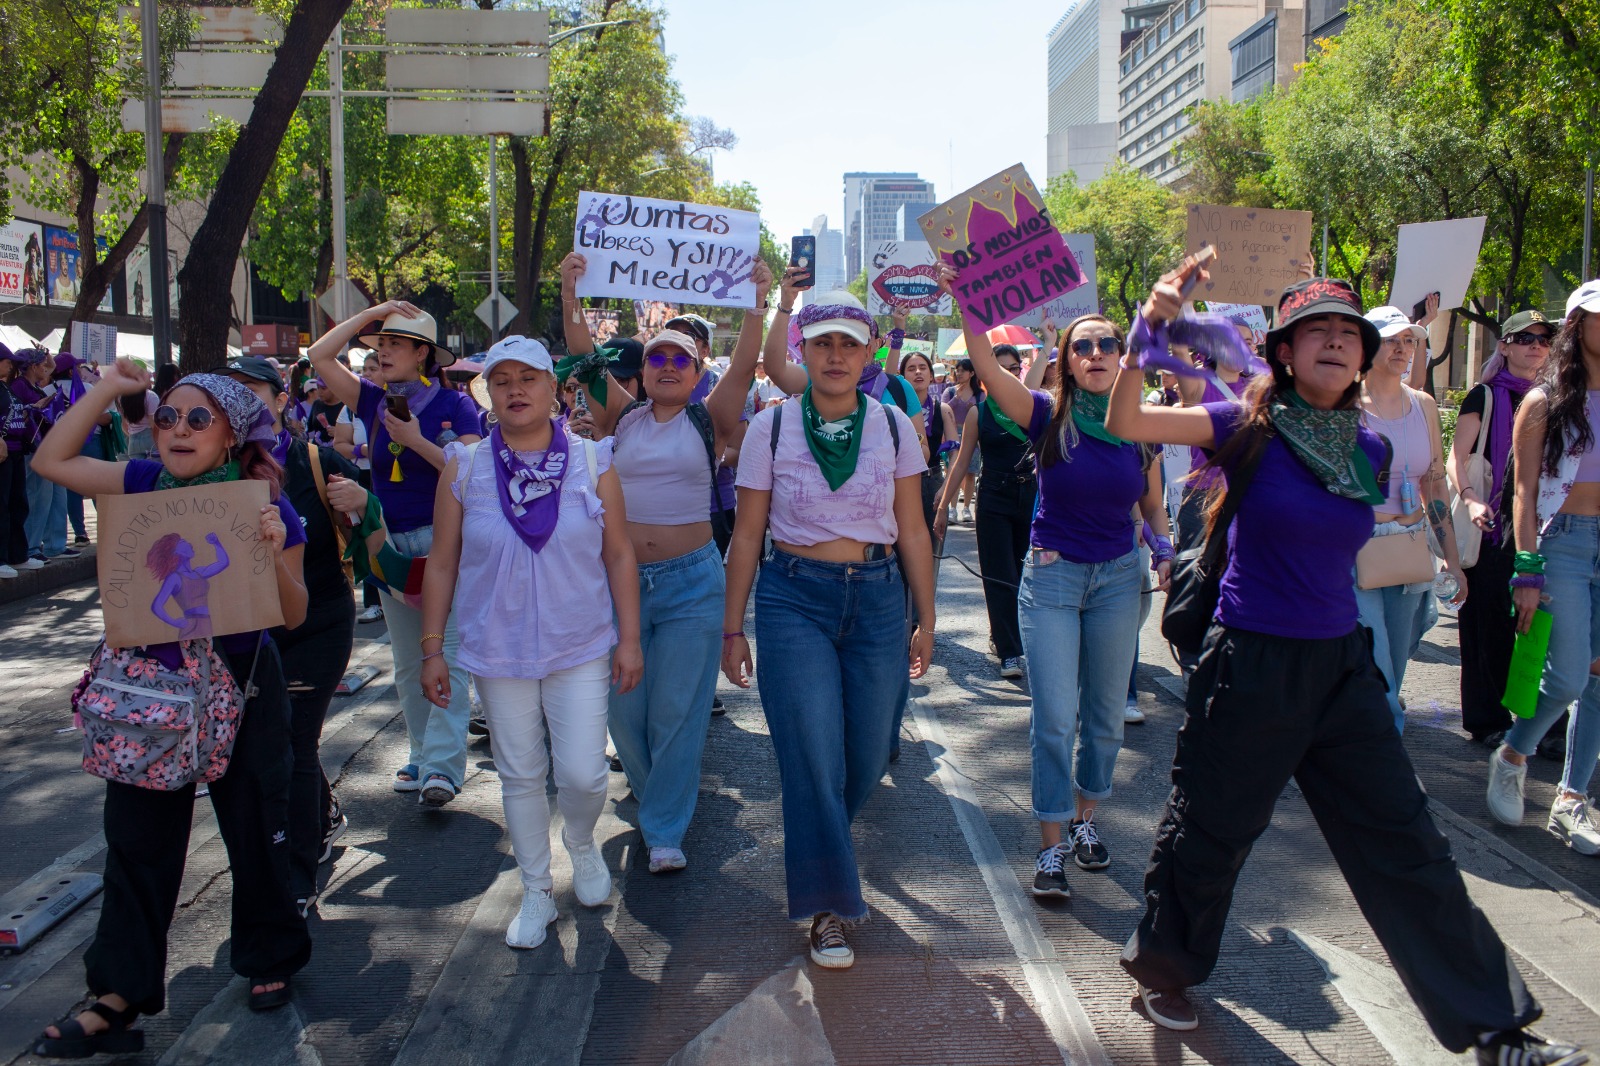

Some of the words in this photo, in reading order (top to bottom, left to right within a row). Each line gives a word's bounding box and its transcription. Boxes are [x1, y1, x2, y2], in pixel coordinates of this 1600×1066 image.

[602, 197, 730, 234] Juntas
[1196, 211, 1222, 233] NO
[1230, 219, 1252, 232] me
[1259, 219, 1297, 234] caben
[668, 239, 687, 267] Y
[952, 242, 983, 269] OS
[984, 208, 1052, 255] NOVIOS
[1216, 235, 1233, 252] las
[609, 261, 710, 293] Miedo
[957, 244, 1054, 299] TAMBIÉN
[1220, 260, 1236, 274] las
[1243, 264, 1265, 278] que
[1269, 267, 1300, 281] estoy
[967, 257, 1081, 327] VIOLAN
[1529, 310, 1544, 322] LA
[104, 504, 162, 609] CALLADITAS
[165, 499, 188, 518] NO
[192, 497, 229, 519] NOS
